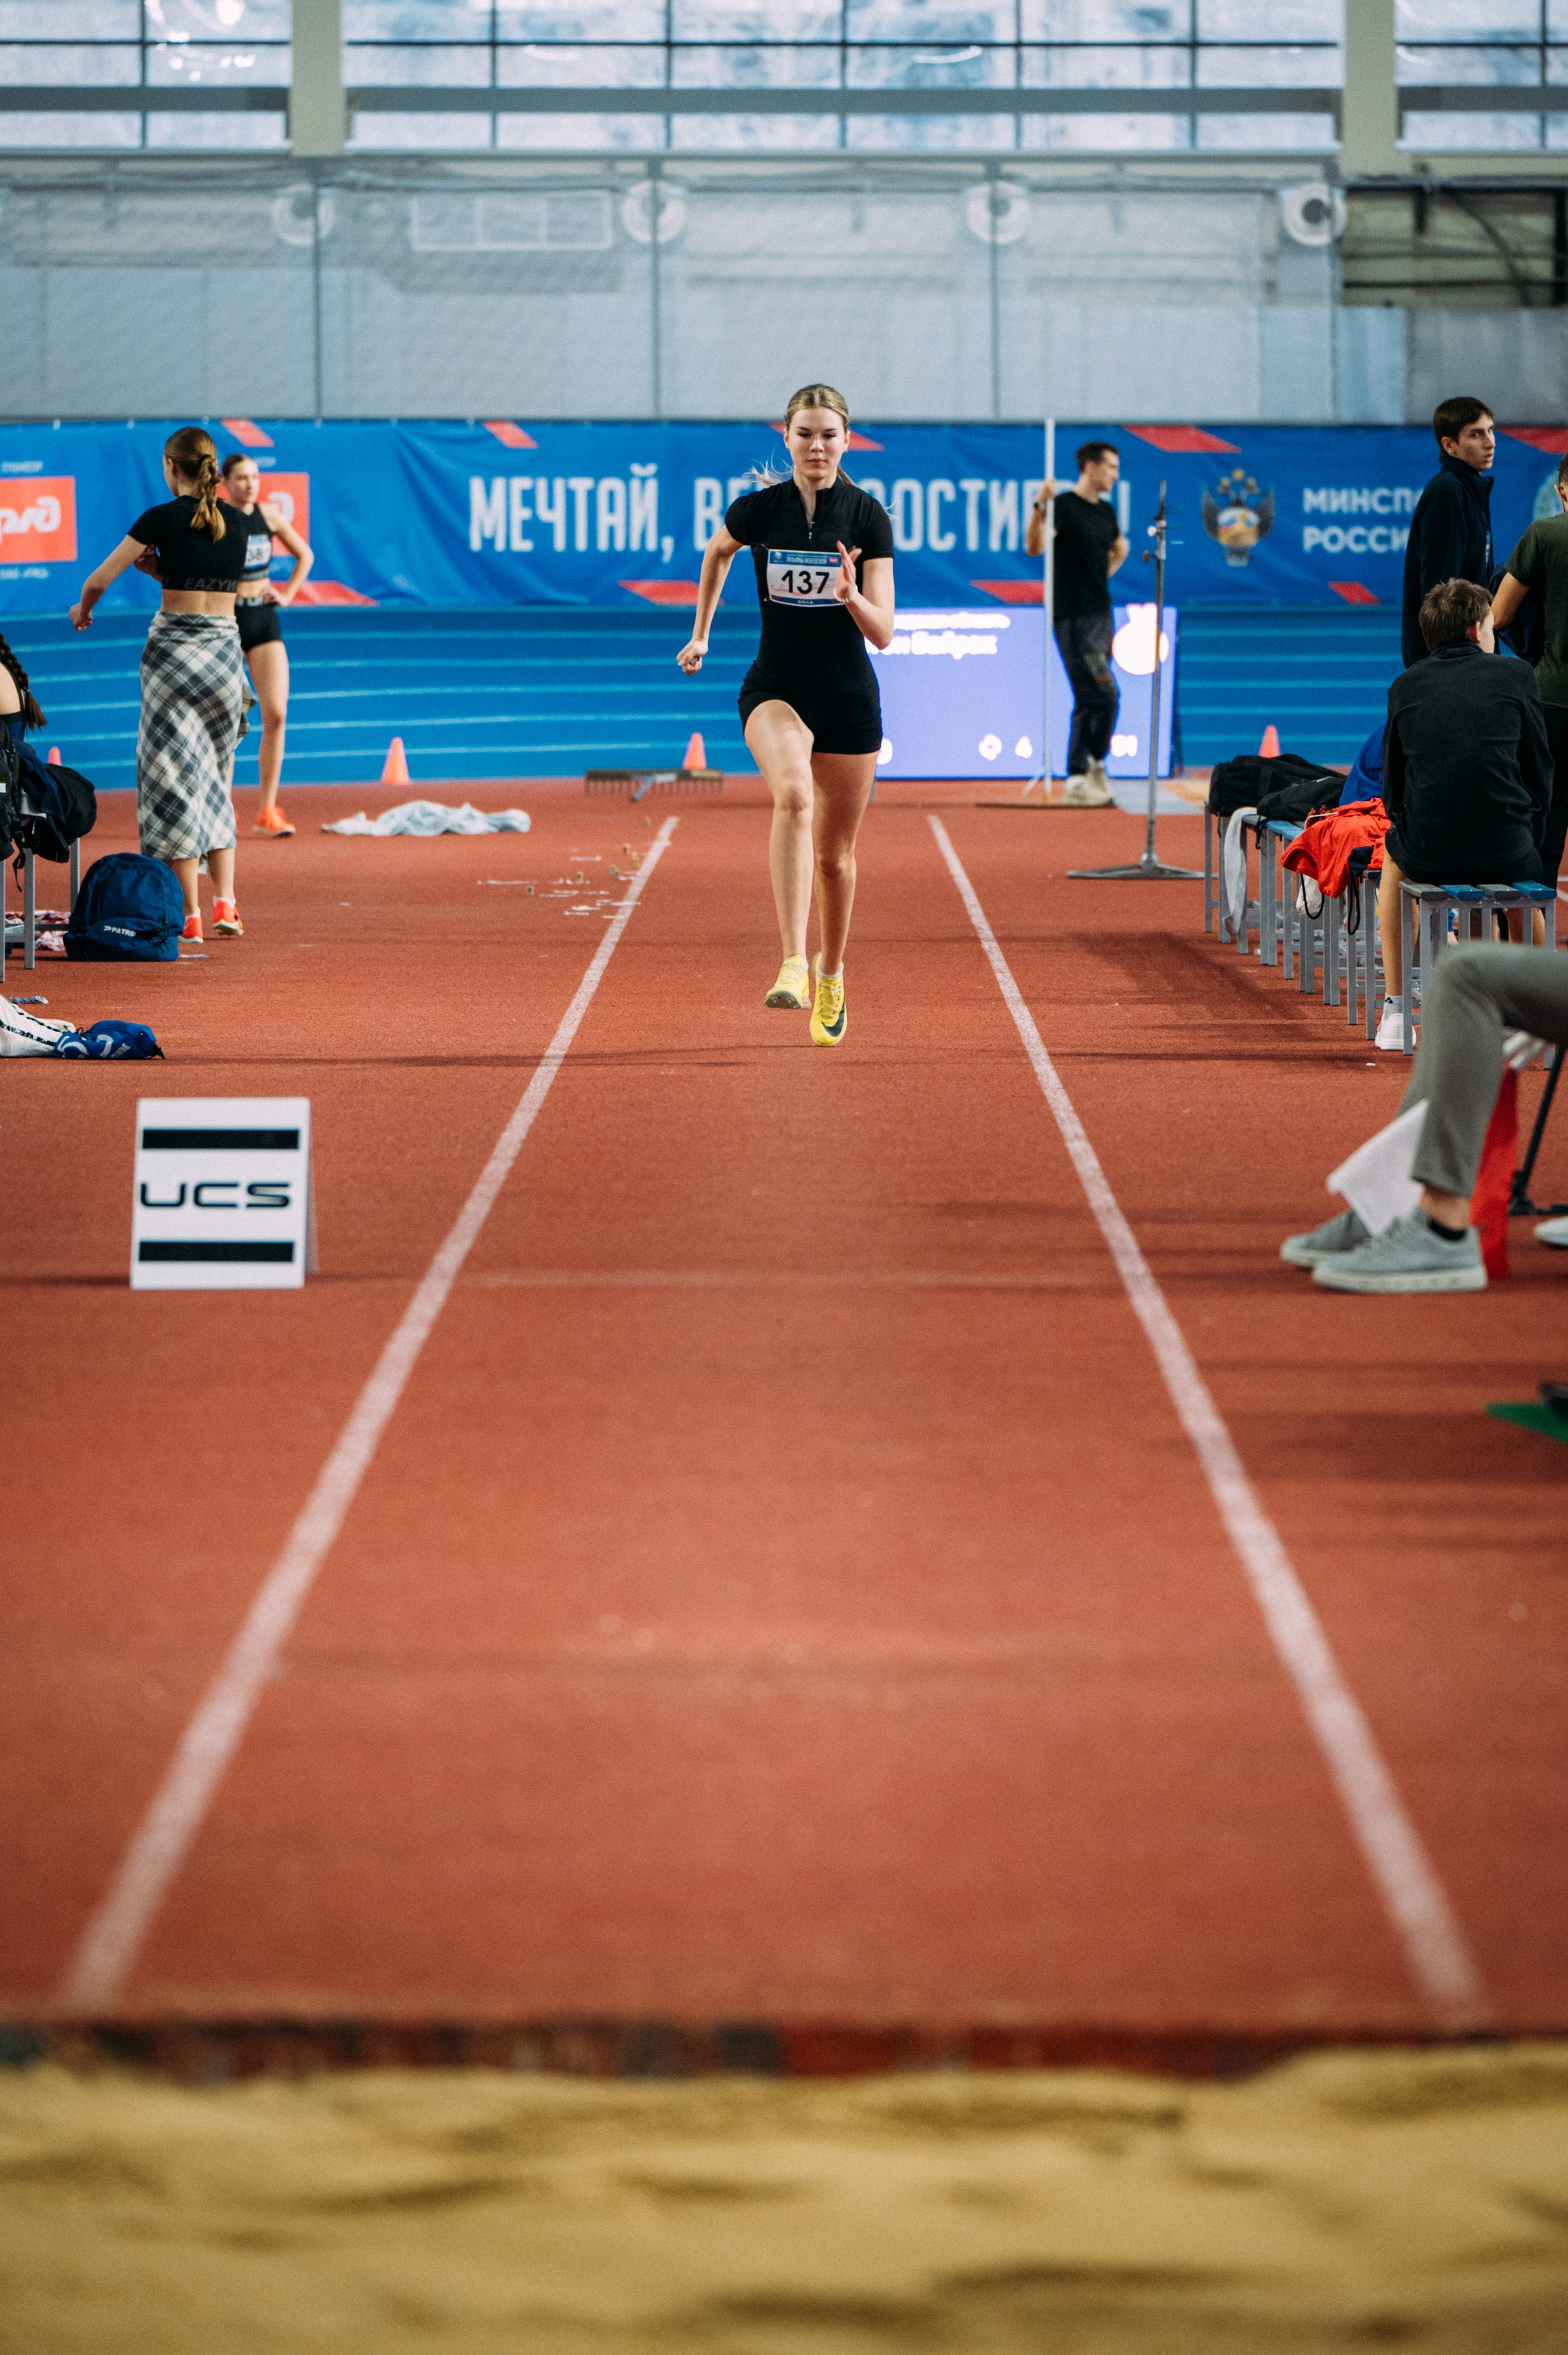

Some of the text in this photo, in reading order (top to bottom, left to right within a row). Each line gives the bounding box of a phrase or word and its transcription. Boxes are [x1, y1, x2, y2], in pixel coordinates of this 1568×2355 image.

[469, 463, 674, 563] МЕЧТАЙ,
[1303, 487, 1425, 514] МИНСП
[781, 570, 830, 594] 137
[140, 1182, 290, 1208] UCS
